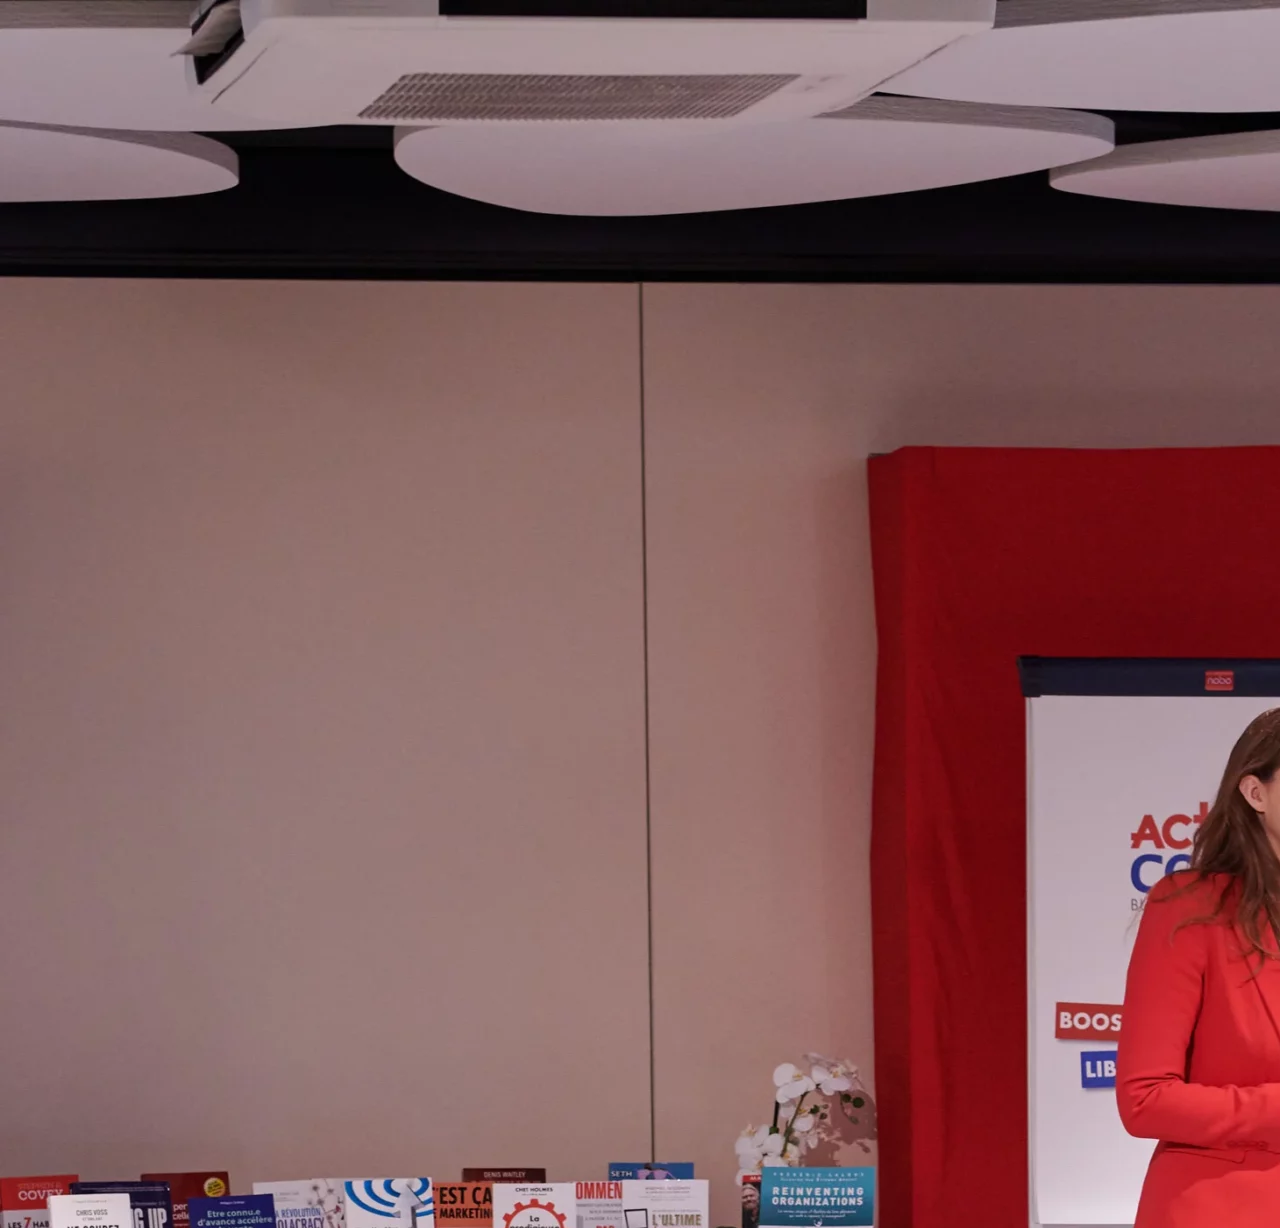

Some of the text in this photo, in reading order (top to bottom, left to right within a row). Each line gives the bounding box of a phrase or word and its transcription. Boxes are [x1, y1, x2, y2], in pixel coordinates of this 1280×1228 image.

[1207, 676, 1232, 685] nobo
[432, 1186, 467, 1205] 'EST
[772, 1186, 865, 1196] REINVENTING
[771, 1197, 864, 1206] ORGANIZATIONS
[281, 1207, 321, 1218] RÉVOLUTION
[198, 1219, 236, 1227] d'avance
[652, 1214, 702, 1226] L'ULTIME
